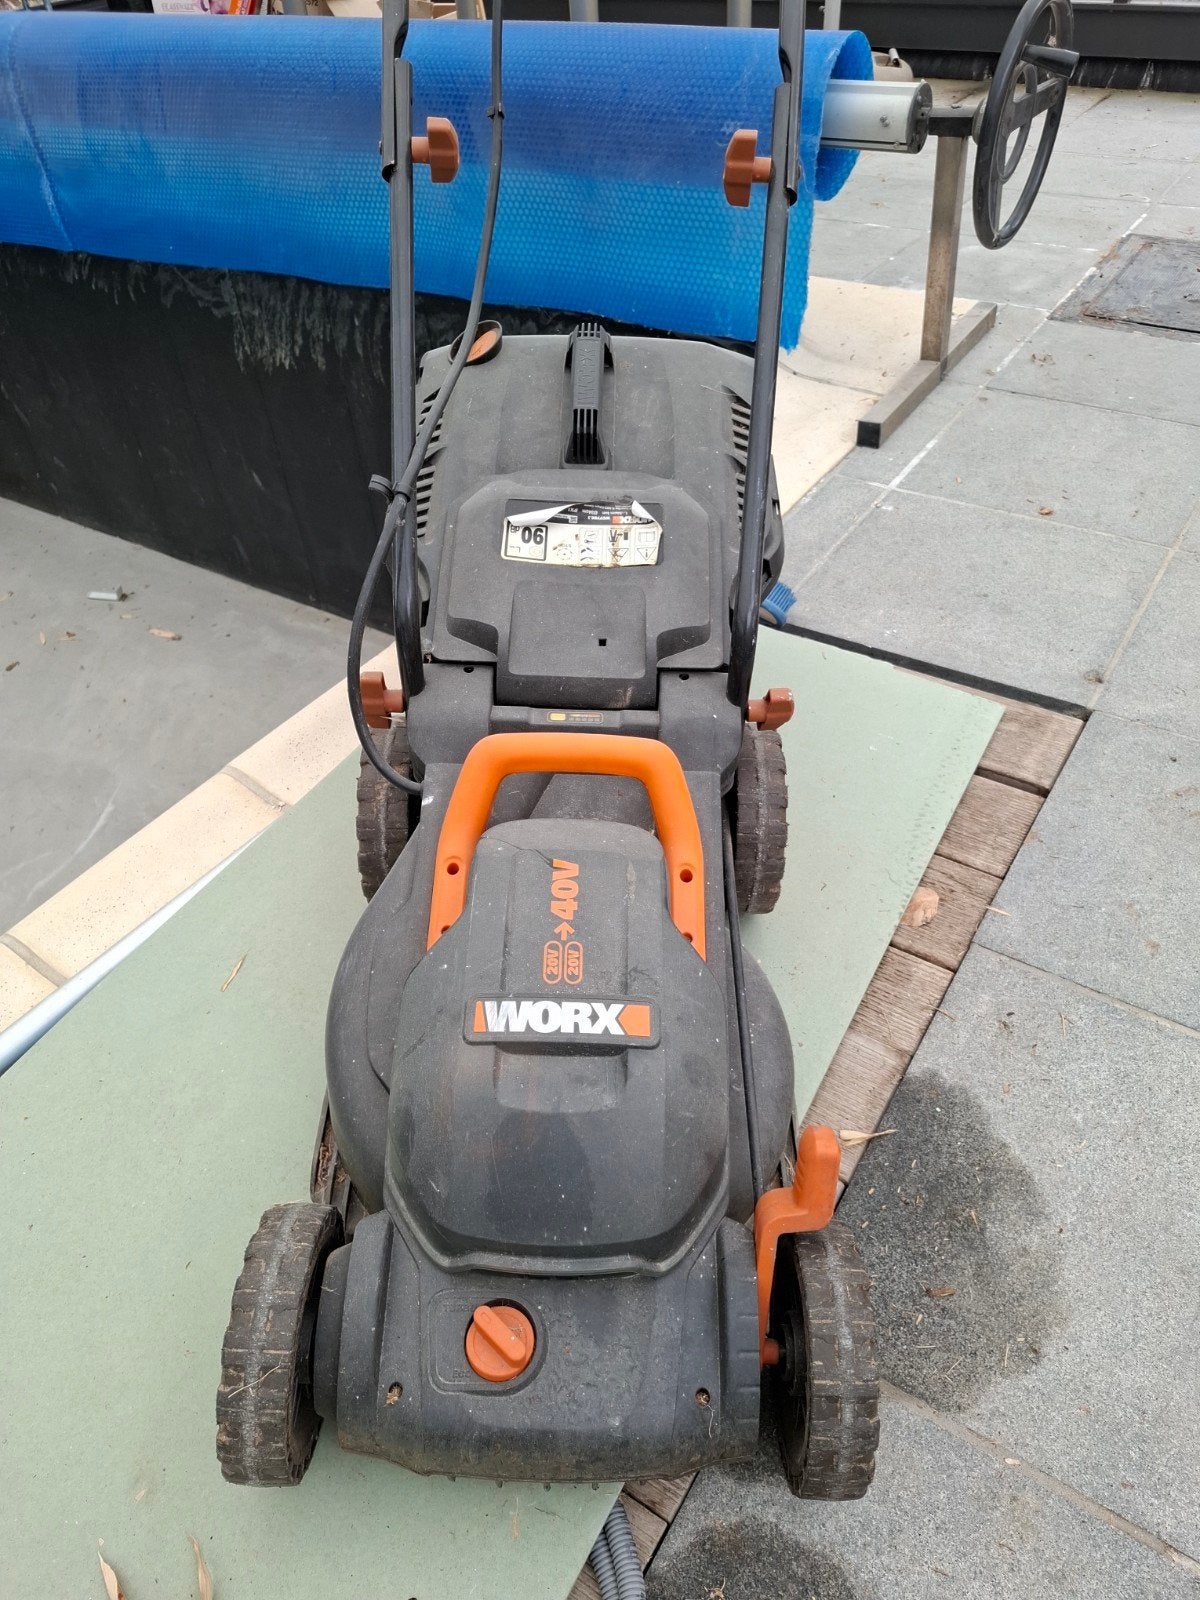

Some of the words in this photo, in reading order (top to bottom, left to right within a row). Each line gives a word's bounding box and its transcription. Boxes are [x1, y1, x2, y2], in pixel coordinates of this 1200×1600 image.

[550, 858, 580, 921] 40V
[546, 949, 559, 975] 20V
[567, 949, 580, 976] 20V
[484, 1000, 626, 1036] WORX
